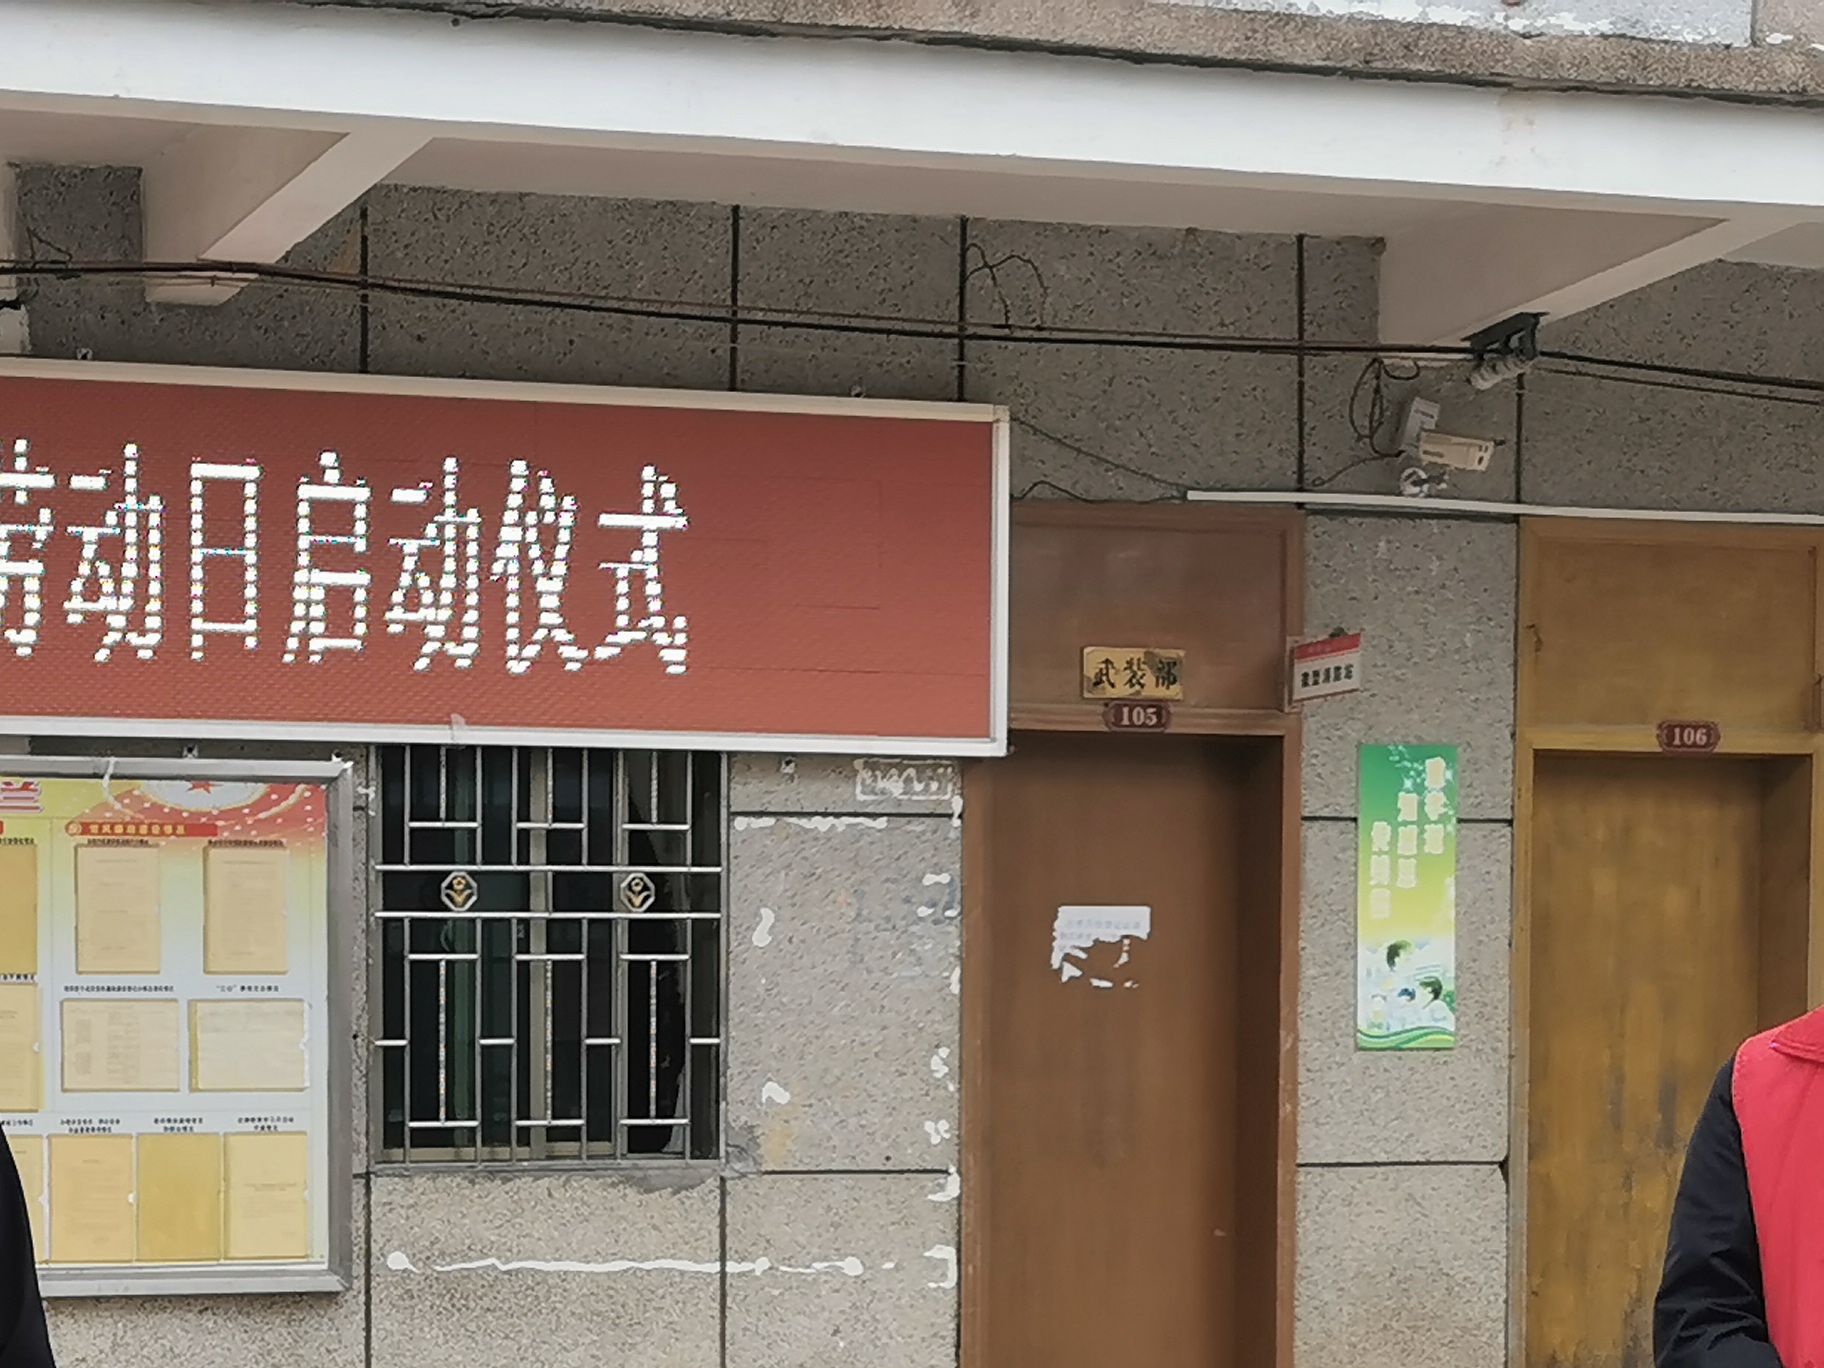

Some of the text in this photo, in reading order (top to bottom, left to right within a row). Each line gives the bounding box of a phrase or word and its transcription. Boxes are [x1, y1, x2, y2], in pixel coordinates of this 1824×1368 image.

[1091, 656, 1180, 690] 武装部
[1120, 705, 1159, 727] 105
[1672, 727, 1707, 746] 106
